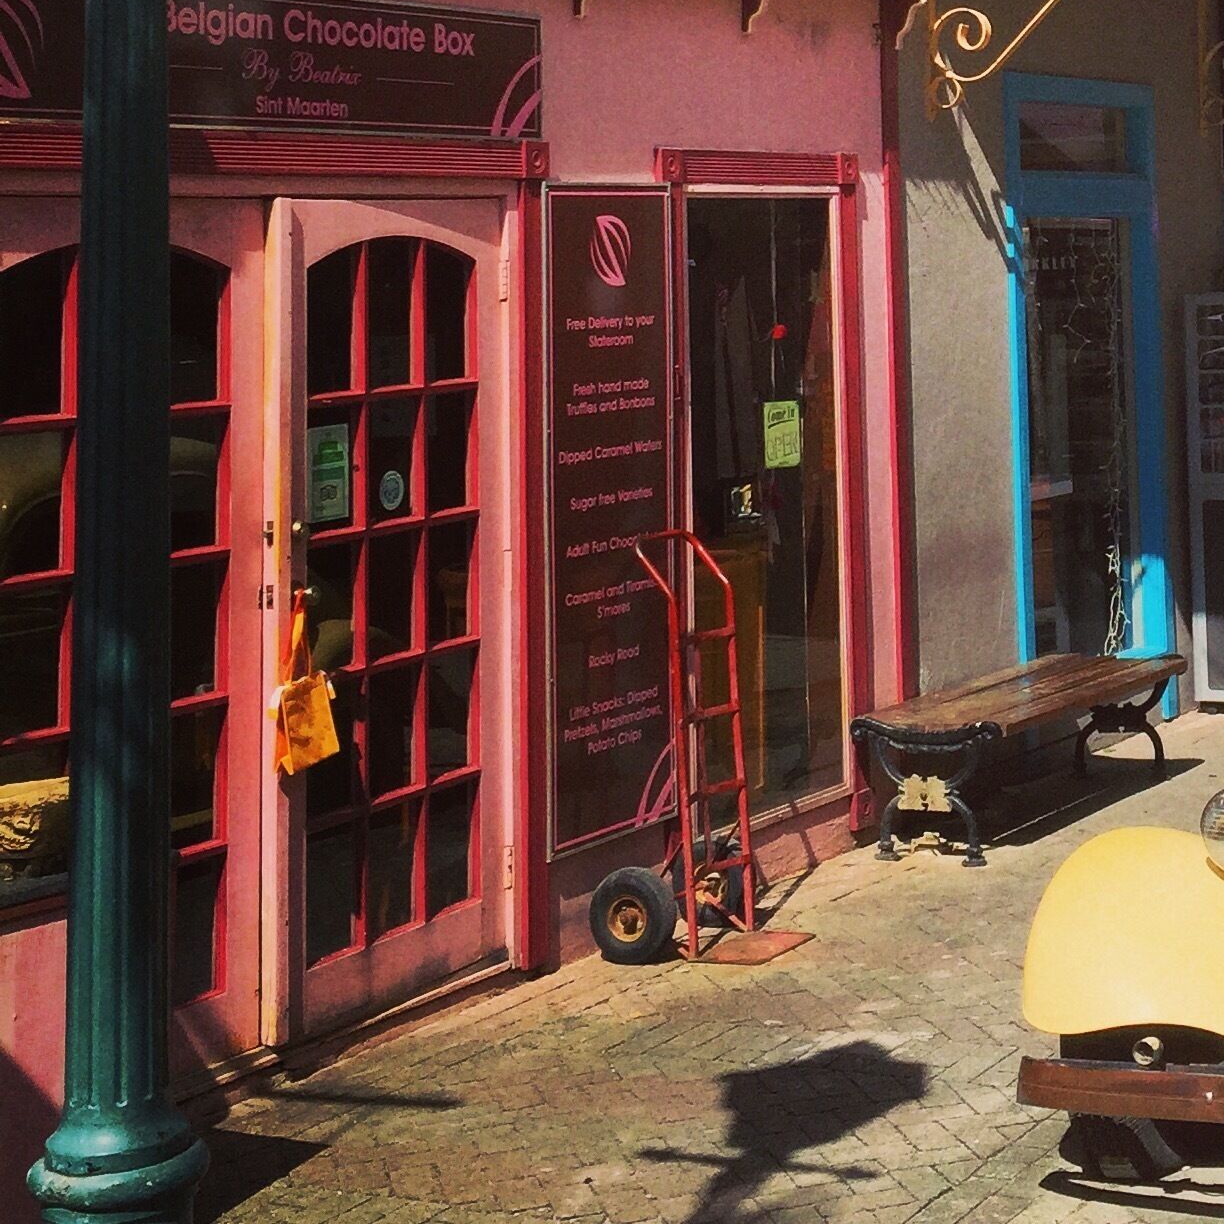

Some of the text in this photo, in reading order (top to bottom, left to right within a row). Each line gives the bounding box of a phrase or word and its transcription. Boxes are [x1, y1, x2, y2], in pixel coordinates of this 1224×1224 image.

[283, 8, 426, 52] Chocolate
[434, 23, 476, 57] Box
[242, 48, 280, 92] By
[255, 95, 350, 118] Sint Maarten
[566, 315, 655, 330] Free Delivery to your
[588, 335, 634, 348] Stateroom
[573, 378, 650, 396] Fresh hand made
[566, 396, 655, 416] Truffles and Bonbons
[559, 439, 662, 465] Dipped Caramel Wafers
[570, 496, 597, 511] Sugar
[598, 493, 616, 506] free
[592, 540, 607, 553] Fun
[565, 587, 605, 606] Caramel
[606, 583, 625, 597] and
[588, 643, 640, 669] Rocky Road
[568, 706, 590, 722] Little
[627, 685, 659, 705] Dipped
[587, 728, 643, 756] Potato Chips
